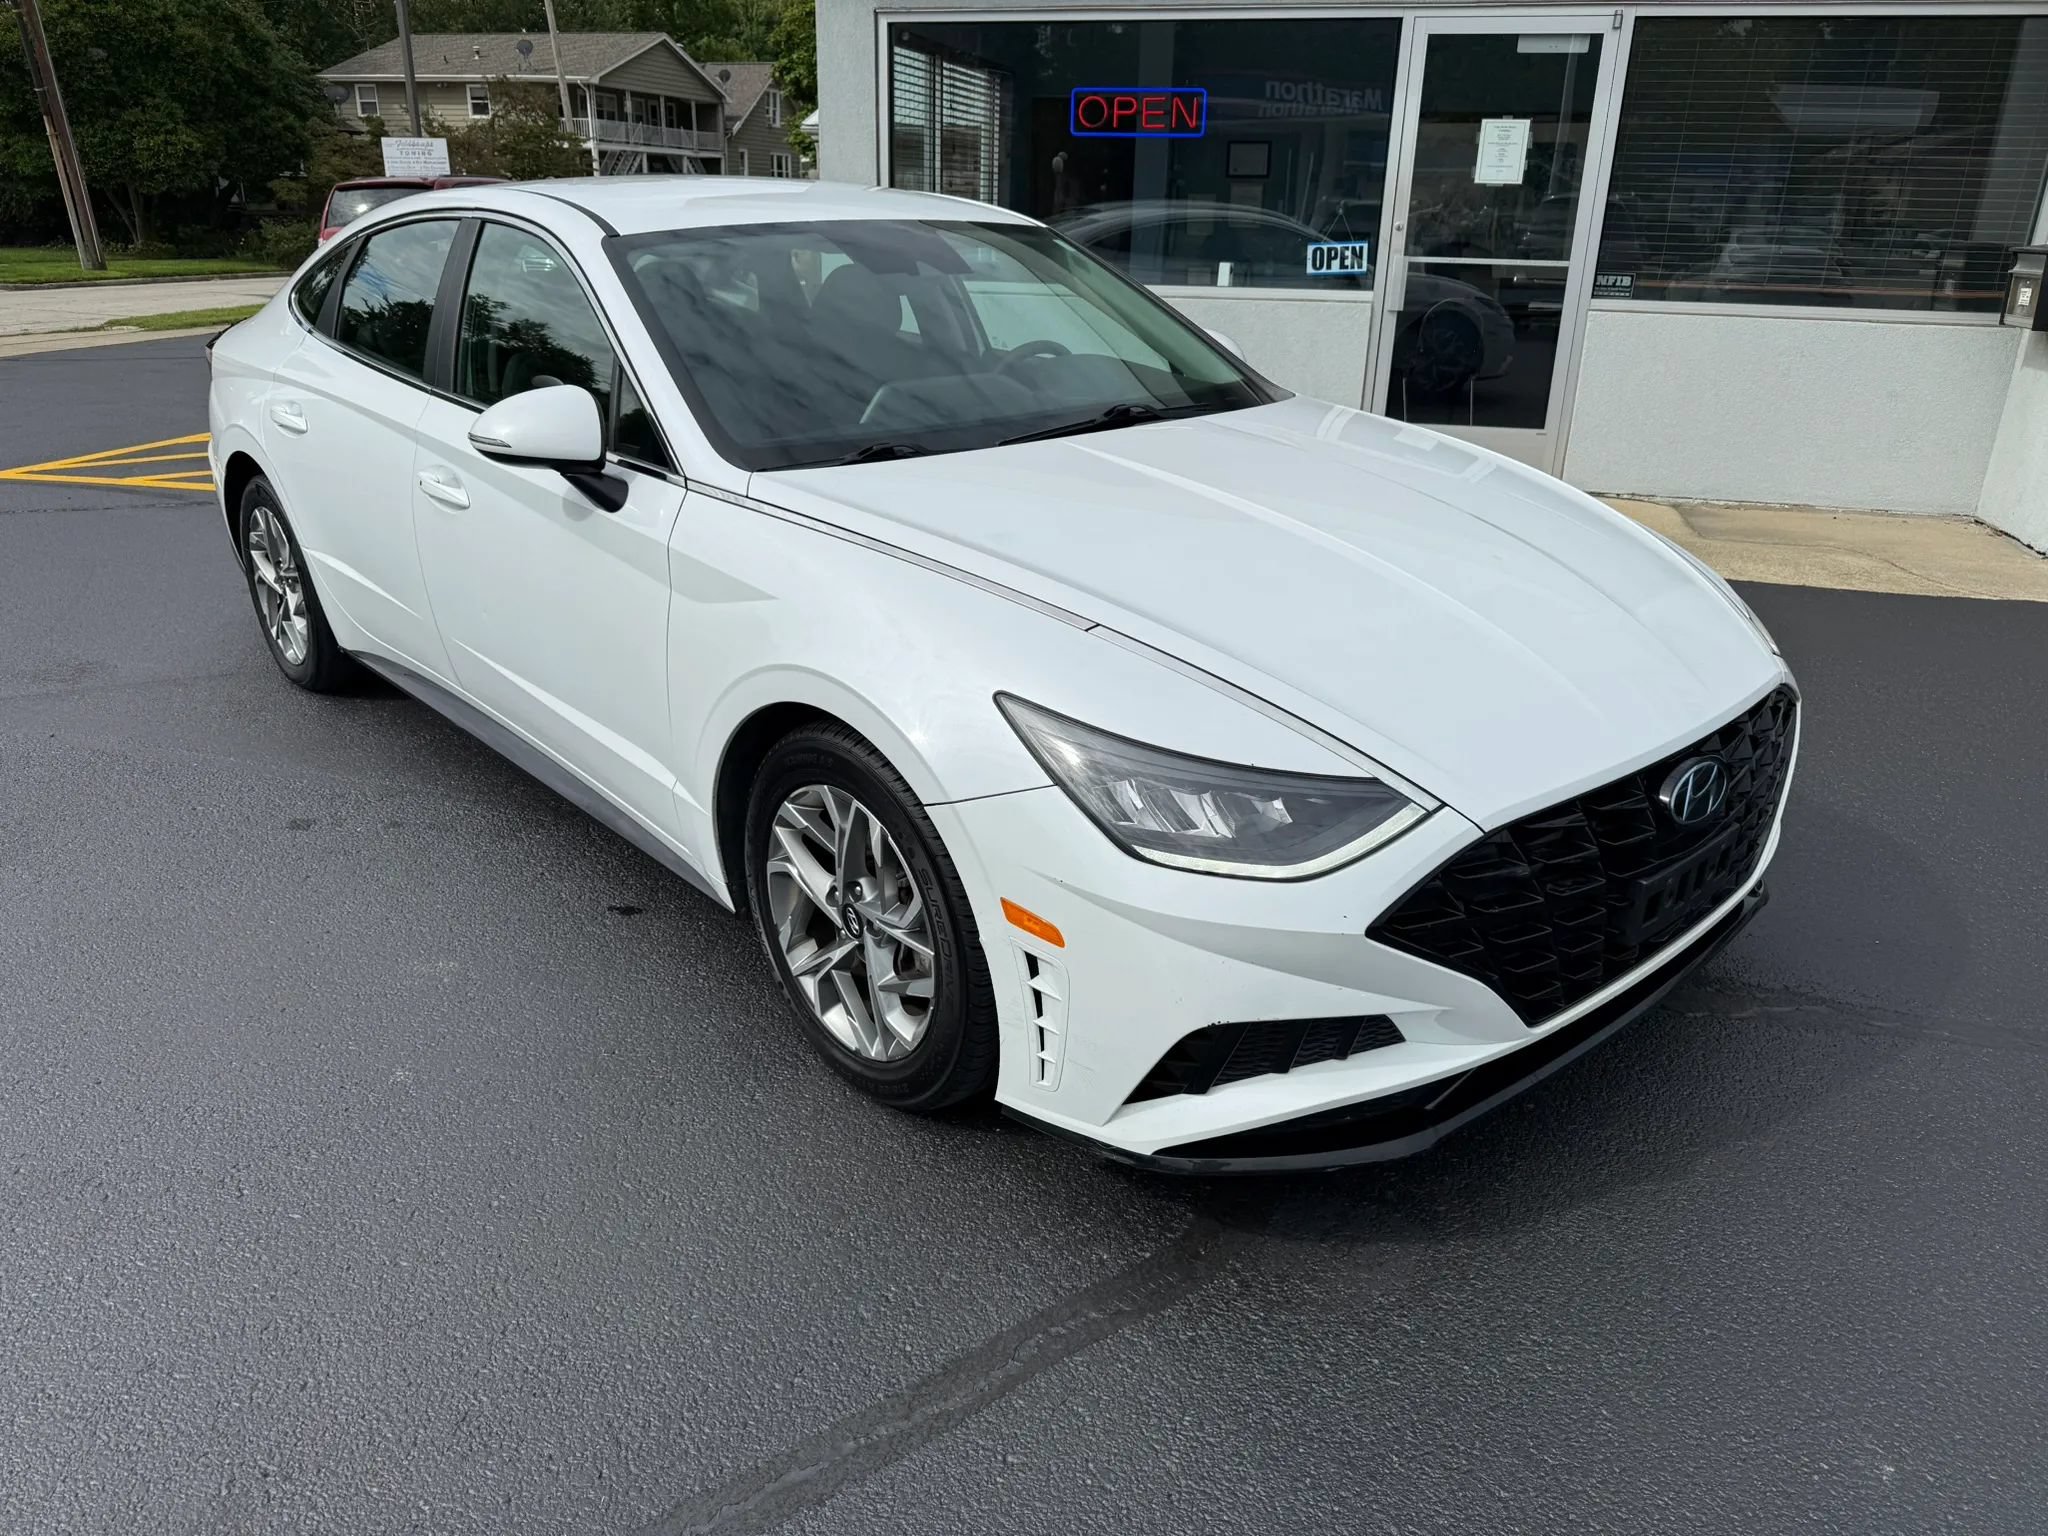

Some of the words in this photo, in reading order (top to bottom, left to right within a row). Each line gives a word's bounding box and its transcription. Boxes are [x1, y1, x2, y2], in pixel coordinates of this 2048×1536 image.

[1077, 95, 1200, 129] OPEN
[1311, 245, 1364, 271] OPEN
[1595, 274, 1632, 287] NFIB
[919, 868, 955, 1007] SUREDRIV
